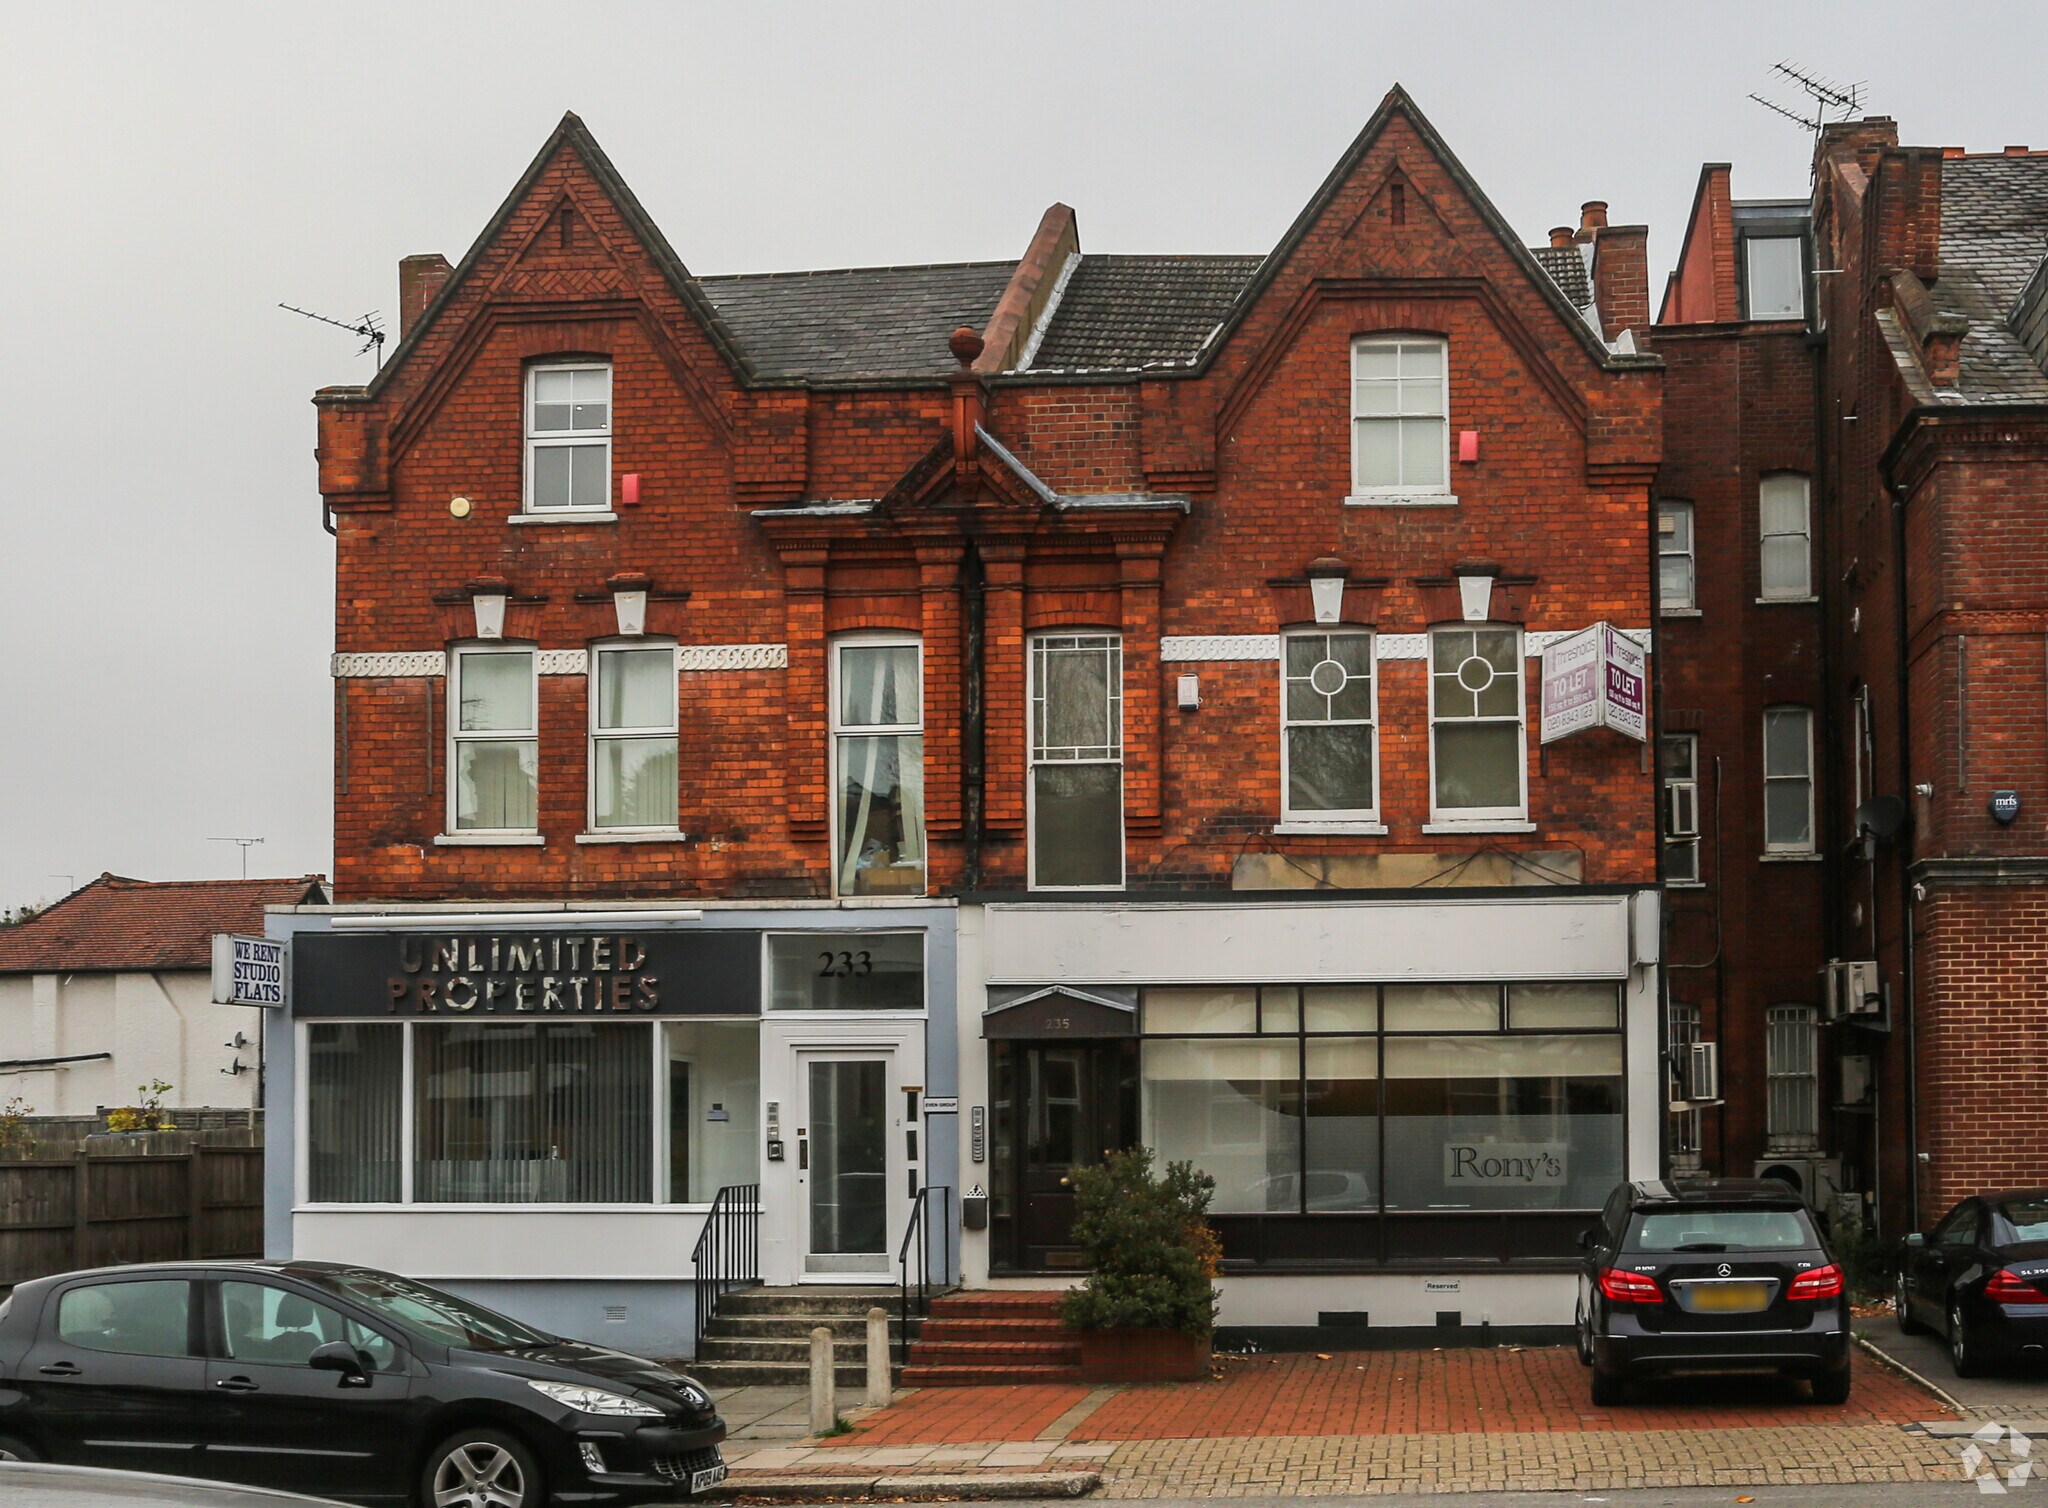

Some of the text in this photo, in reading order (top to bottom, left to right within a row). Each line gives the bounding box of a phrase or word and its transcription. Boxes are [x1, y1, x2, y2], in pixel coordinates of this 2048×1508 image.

[1552, 667, 1588, 698] TO LET
[1611, 667, 1636, 697] TO LET
[1547, 715, 1560, 731] 020
[1995, 795, 2017, 806] mrfs
[234, 941, 281, 963] WE RENT
[401, 936, 647, 974] UNLIMITED
[818, 950, 872, 978] 233
[234, 961, 280, 983] STUDIO
[234, 981, 281, 1003] FLATS
[387, 975, 659, 1012] PROPERTIES
[1044, 1018, 1070, 1030] 235
[1450, 1146, 1561, 1182] Rony's
